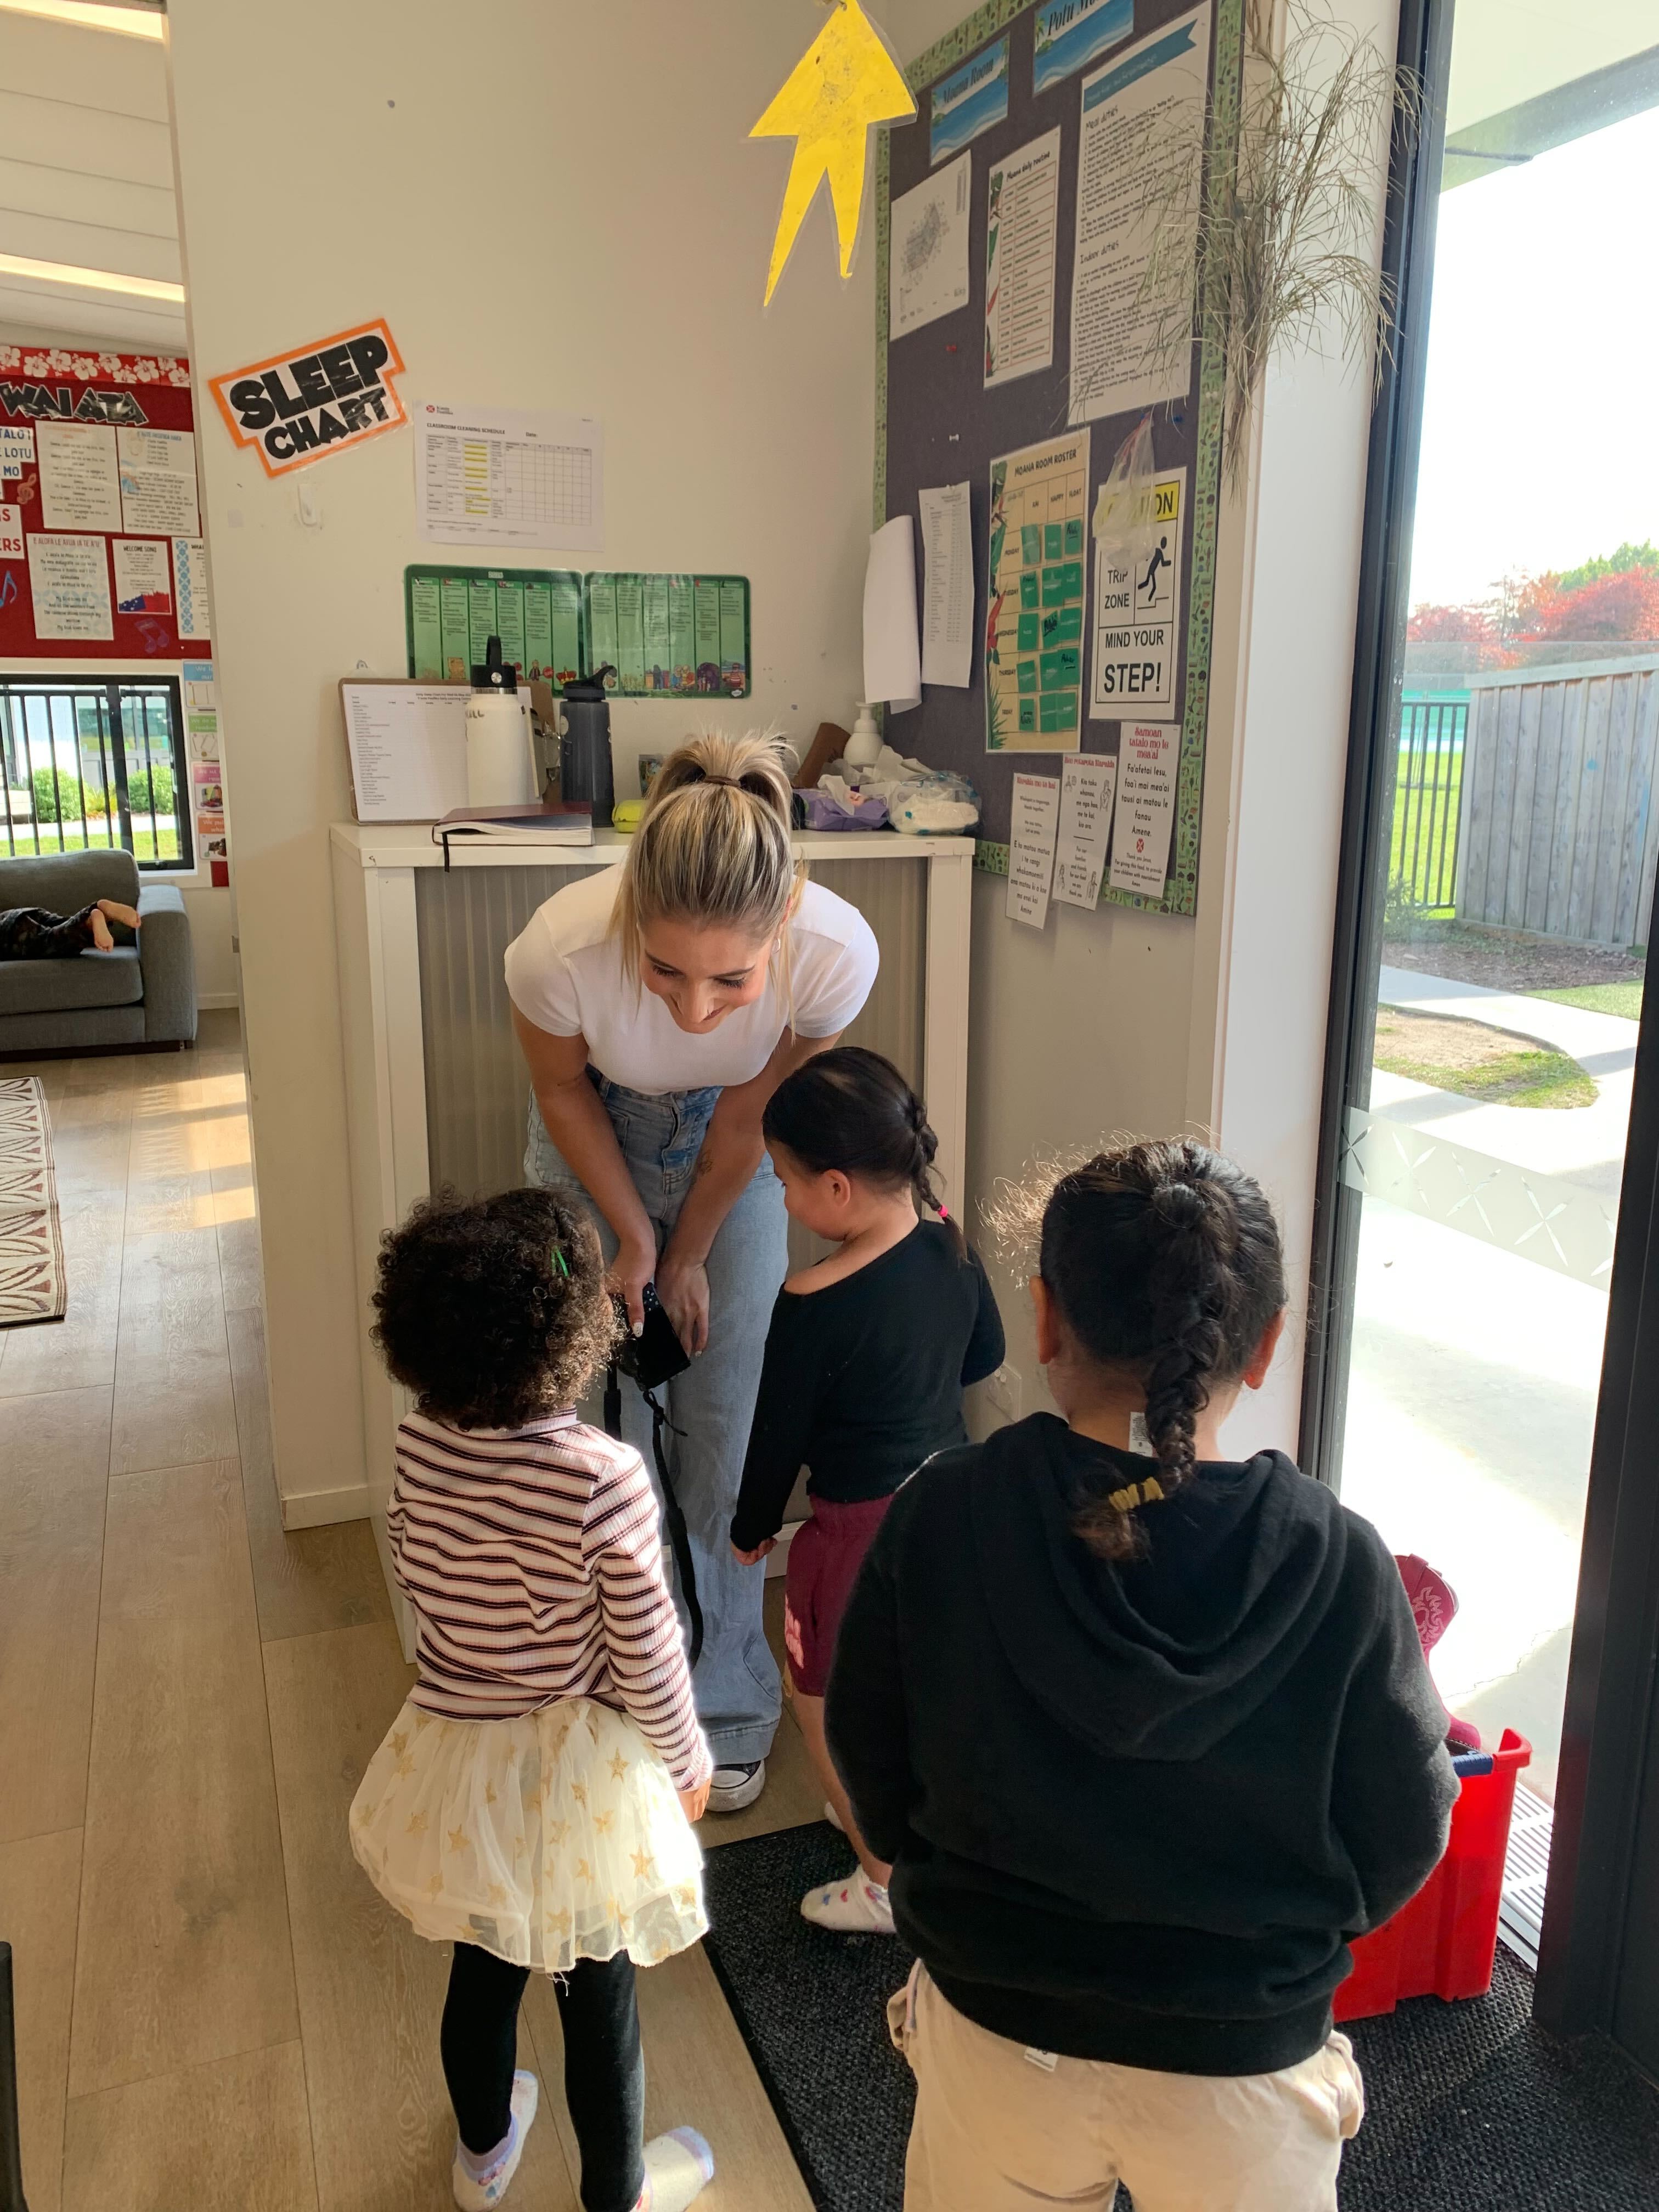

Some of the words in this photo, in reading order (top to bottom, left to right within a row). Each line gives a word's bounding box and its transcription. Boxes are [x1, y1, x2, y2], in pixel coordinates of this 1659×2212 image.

[1080, 250, 1099, 264] Indoor
[229, 335, 388, 430] SLEEP
[264, 386, 390, 460] CHART
[4, 447, 32, 459] LOTU
[1014, 462, 1035, 477] MOANA
[1036, 456, 1053, 470] ROOM
[1054, 448, 1077, 463] ROSTER
[4, 466, 20, 476] MO
[1104, 593, 1130, 609] ZONE
[1105, 631, 1130, 648] MIND
[1133, 629, 1164, 646] YOUR
[1104, 662, 1161, 693] STEP!
[1135, 726, 1162, 737] Samoan
[1129, 738, 1148, 748] tatalo
[1127, 763, 1152, 775] Fa'afetai
[1138, 781, 1149, 789] mai
[1150, 782, 1169, 792] mea'ai
[1121, 794, 1135, 803] tausi
[1143, 799, 1161, 807] matou
[1163, 798, 1168, 808] le
[1135, 810, 1152, 821] fanau
[1132, 825, 1152, 837] Amene.
